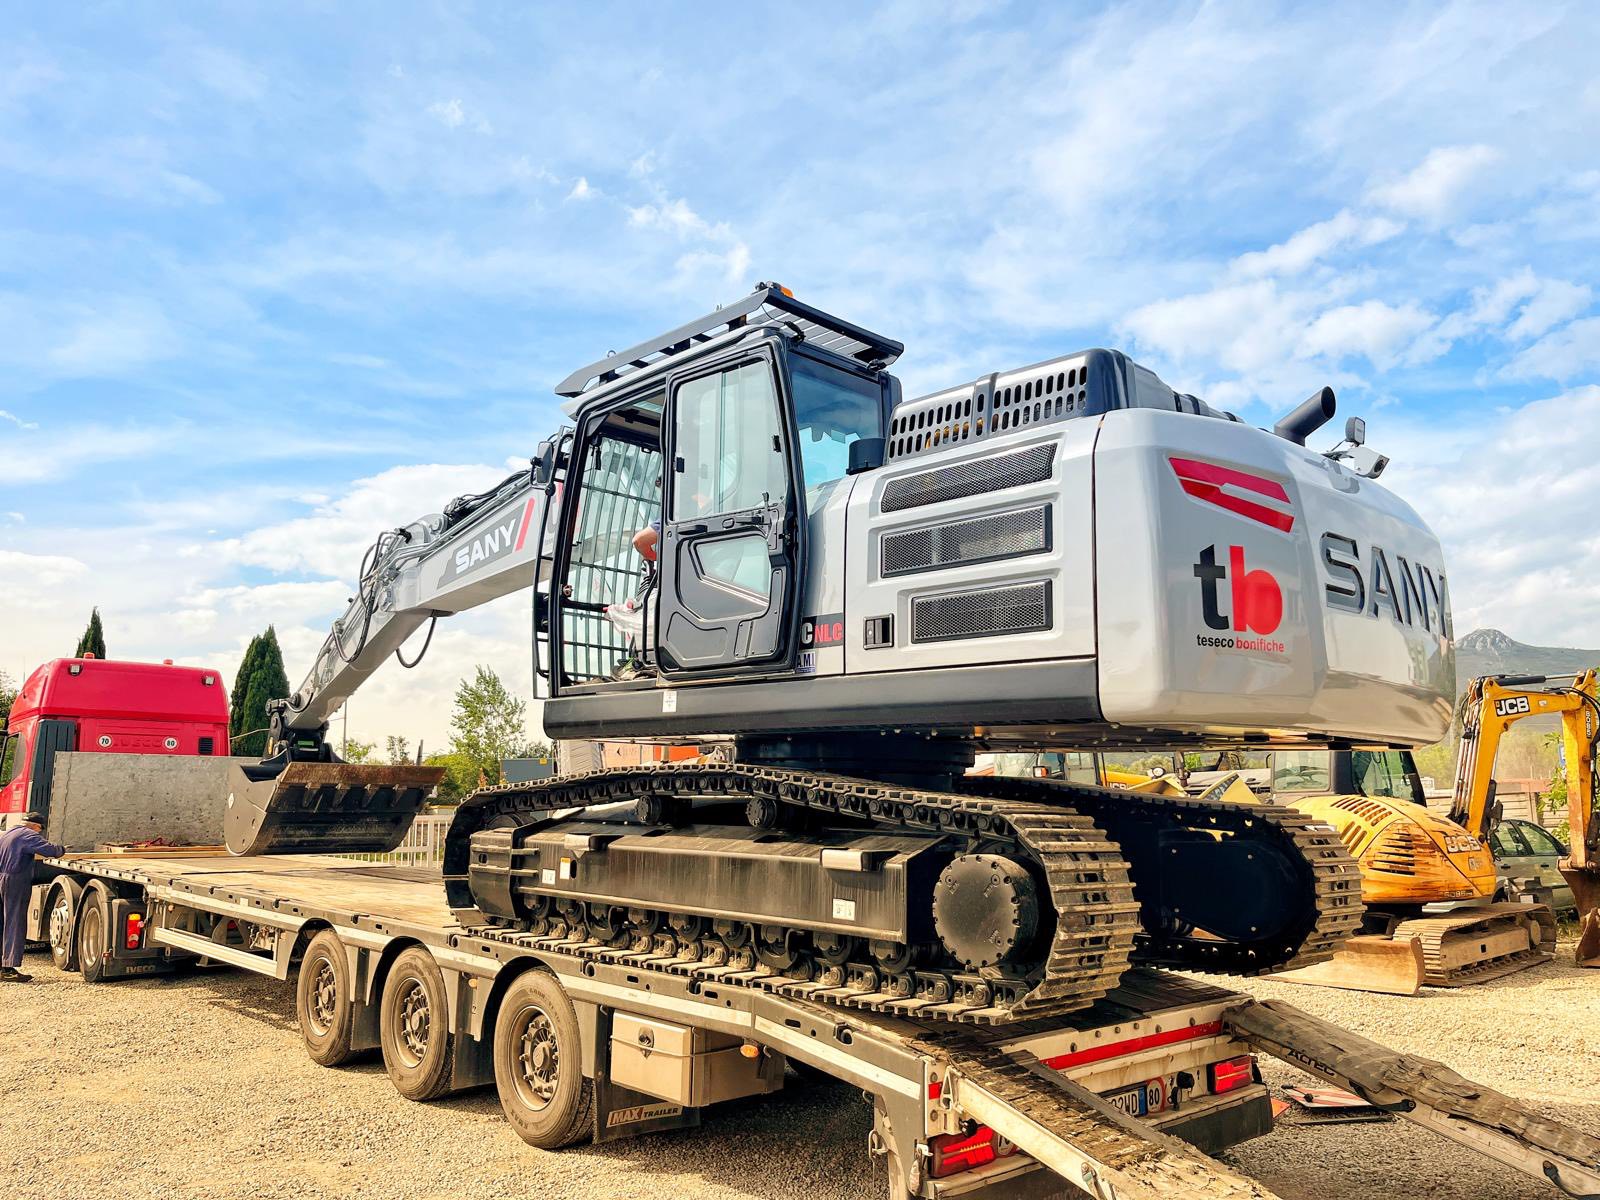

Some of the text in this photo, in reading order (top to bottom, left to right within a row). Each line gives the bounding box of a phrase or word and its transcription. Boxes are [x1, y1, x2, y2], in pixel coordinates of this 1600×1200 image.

[455, 519, 516, 574] SANY
[1193, 544, 1283, 635] tb
[1319, 531, 1446, 639] SANY
[1197, 634, 1284, 652] teseco bonifiche
[1496, 697, 1529, 716] JCB
[126, 965, 156, 974] IVECO
[1149, 1087, 1160, 1106] 80
[612, 1107, 678, 1124] MAX TRAILER
